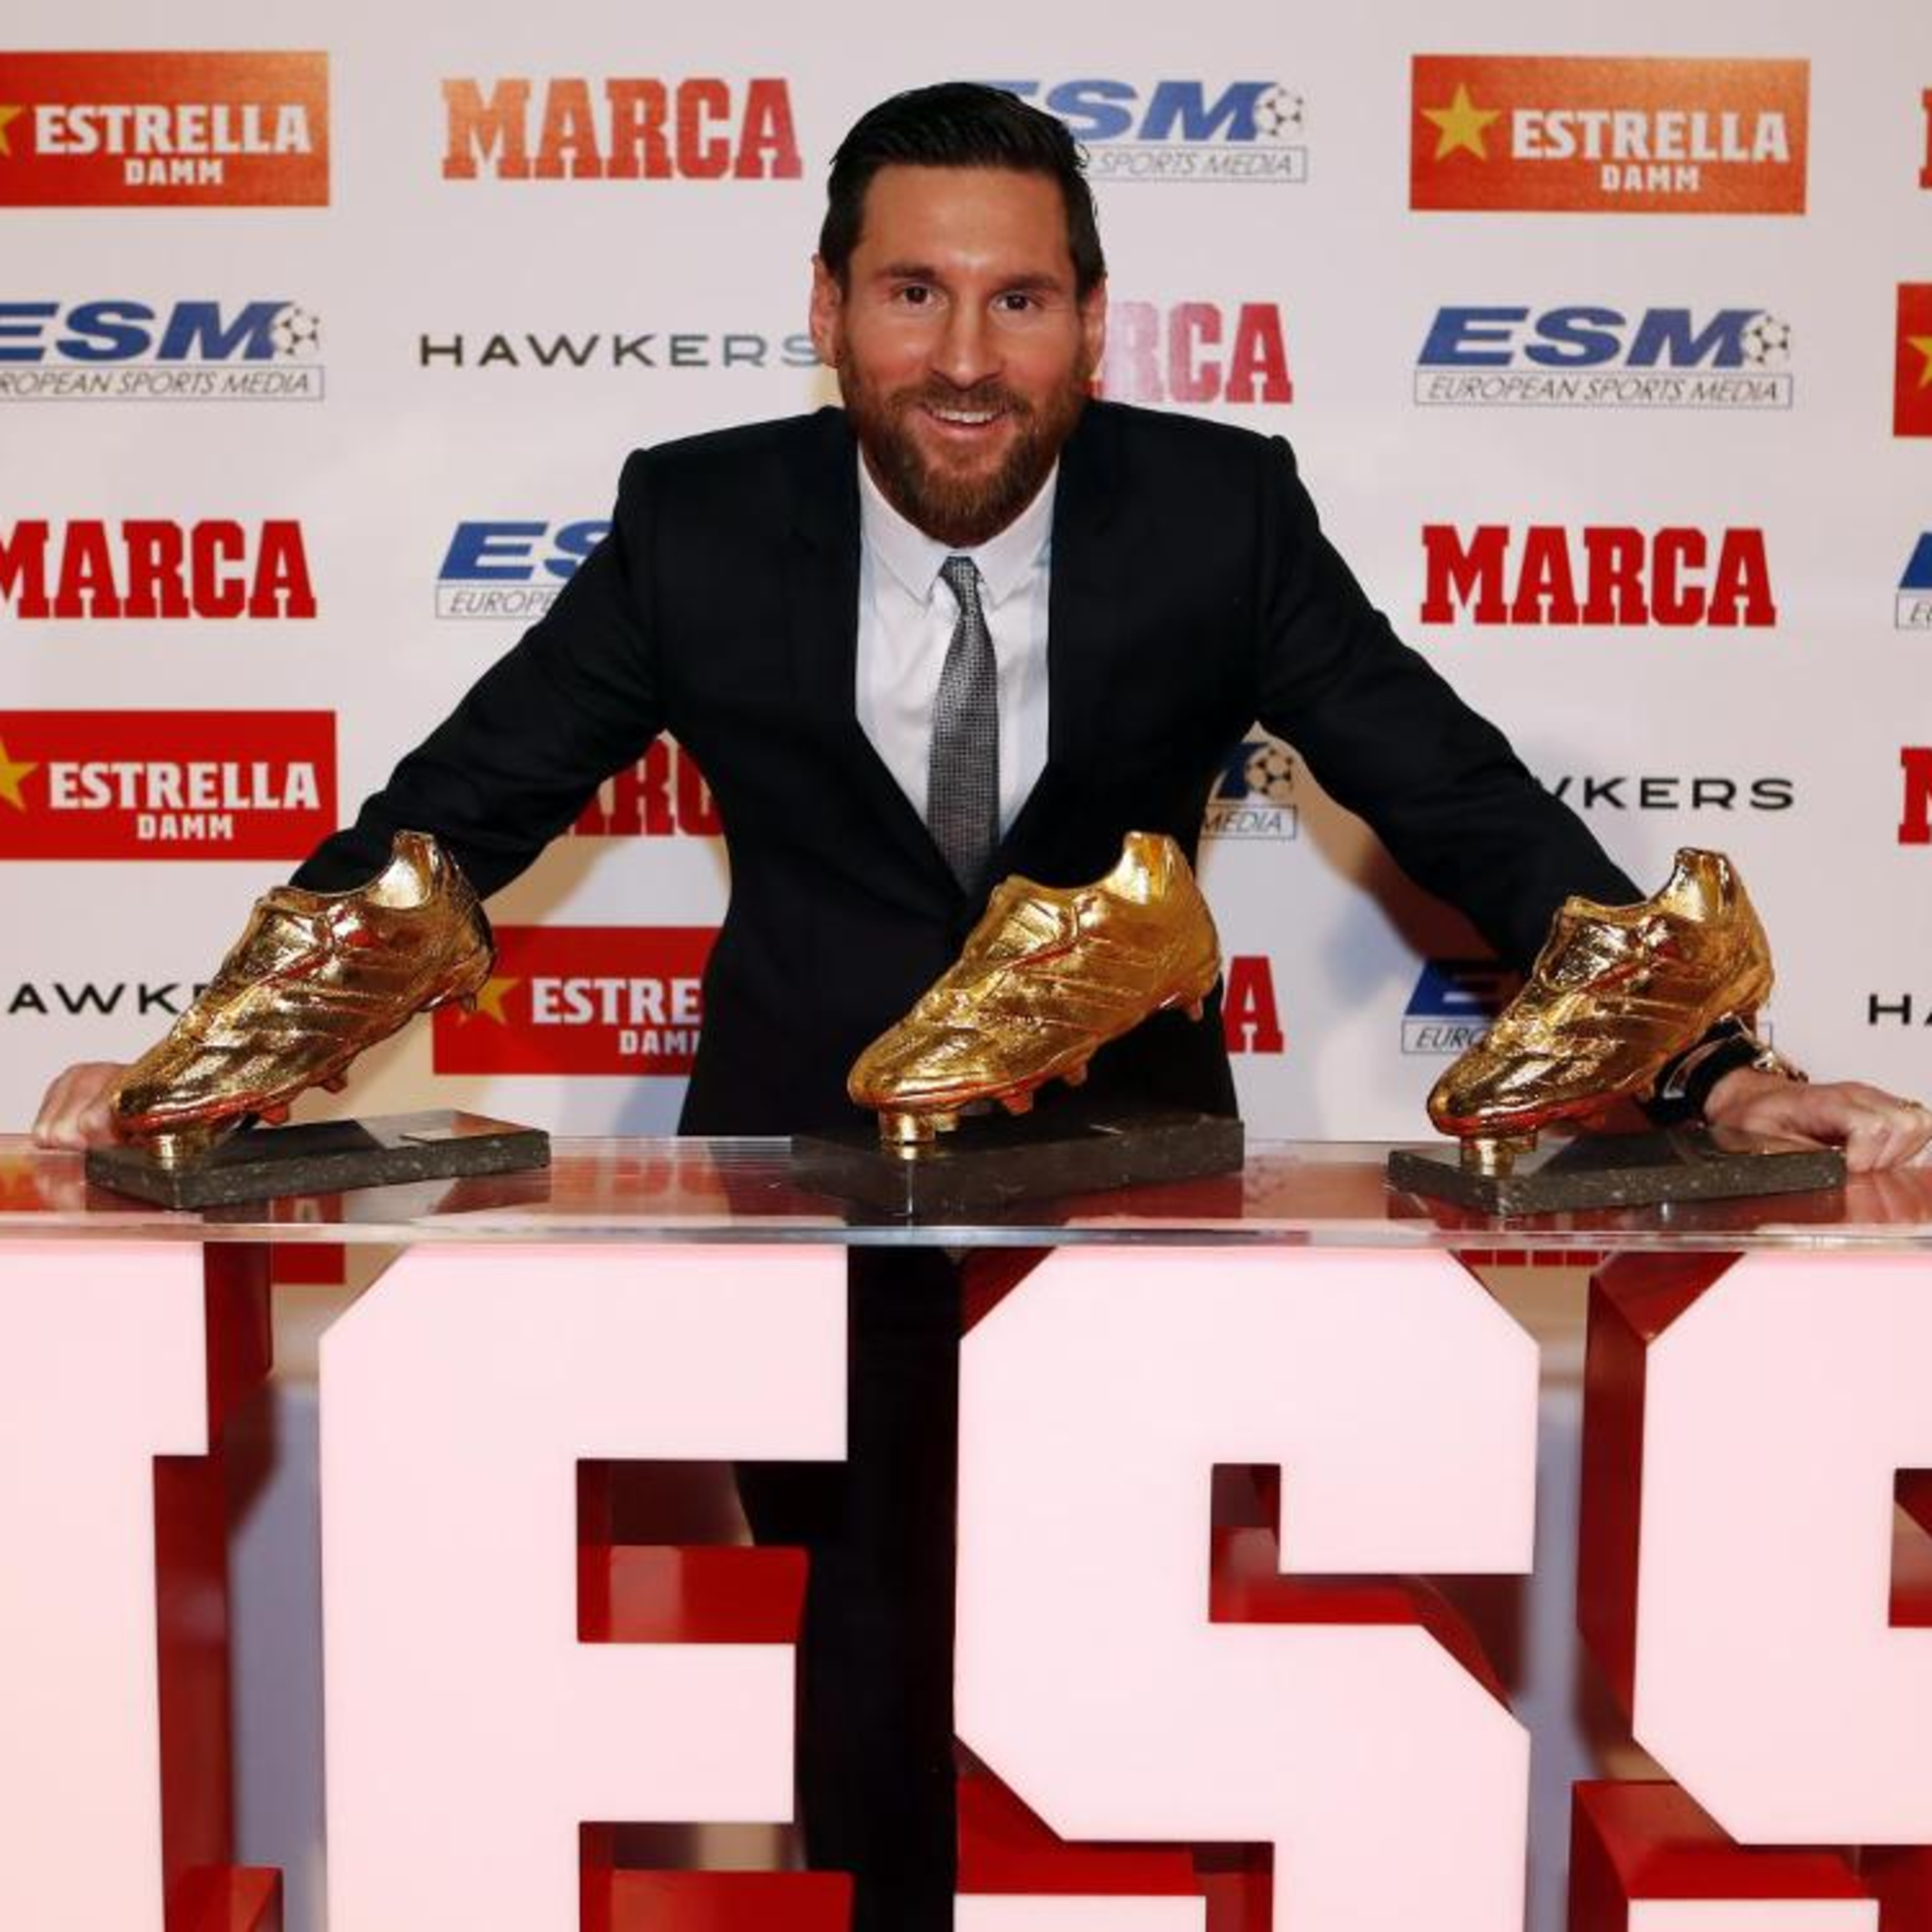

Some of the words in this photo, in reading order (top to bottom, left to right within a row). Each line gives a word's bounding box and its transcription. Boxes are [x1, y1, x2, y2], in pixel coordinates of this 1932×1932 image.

[35, 106, 312, 155] ESTRELLA
[440, 79, 802, 179] MARCA
[989, 79, 1278, 141] SM
[1511, 109, 1790, 162] ESTRELLA
[125, 158, 224, 185] DAMM
[1100, 153, 1197, 175] SPORTS
[1208, 153, 1293, 175] MEDIA
[1601, 164, 1700, 192] DAMM
[419, 334, 823, 368] HAWKERS
[1088, 301, 1294, 404] RCA
[1418, 306, 1766, 368] ESM
[0, 372, 113, 395] ROPEAN
[115, 372, 217, 395] SPORTS
[222, 372, 308, 394] MEDIA
[1428, 375, 1579, 401] EUROPEAN
[1583, 377, 1686, 402] SPORTS
[1690, 379, 1777, 403] MEDIA
[0, 520, 317, 618] MARCA
[439, 520, 613, 580] ES
[1421, 525, 1776, 627] MARCA
[450, 589, 558, 613] EUROP
[48, 762, 321, 810] ESTRELLA
[1554, 776, 1794, 811] KERS
[137, 813, 234, 840] DAMM
[8, 983, 207, 1015] AWK
[532, 978, 700, 1024] ESTRE
